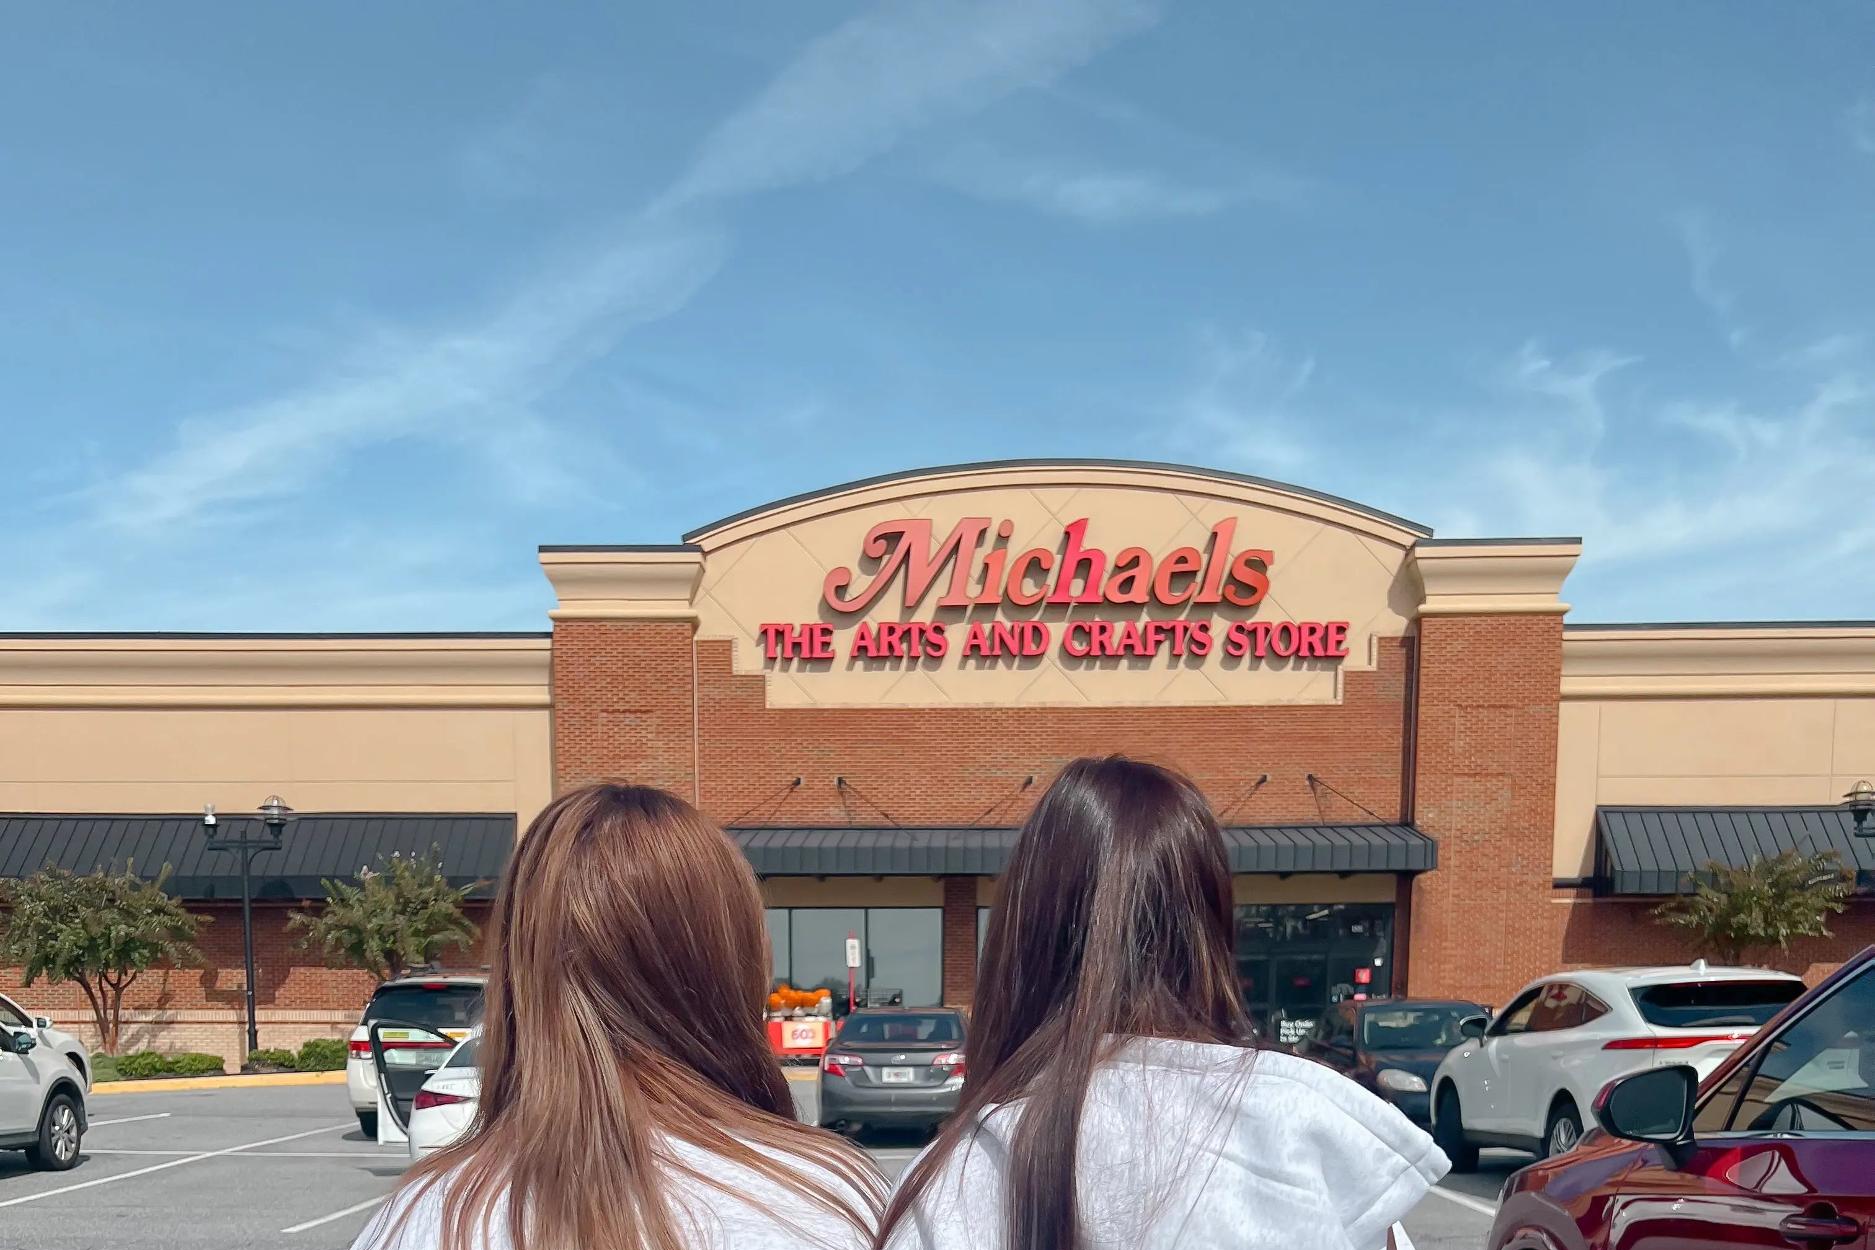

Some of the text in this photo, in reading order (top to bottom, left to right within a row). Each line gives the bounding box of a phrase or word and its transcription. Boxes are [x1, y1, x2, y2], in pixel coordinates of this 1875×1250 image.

[823, 516, 1275, 613] Michaels
[759, 620, 1350, 660] THE ARTS AND CRAFTS STORE
